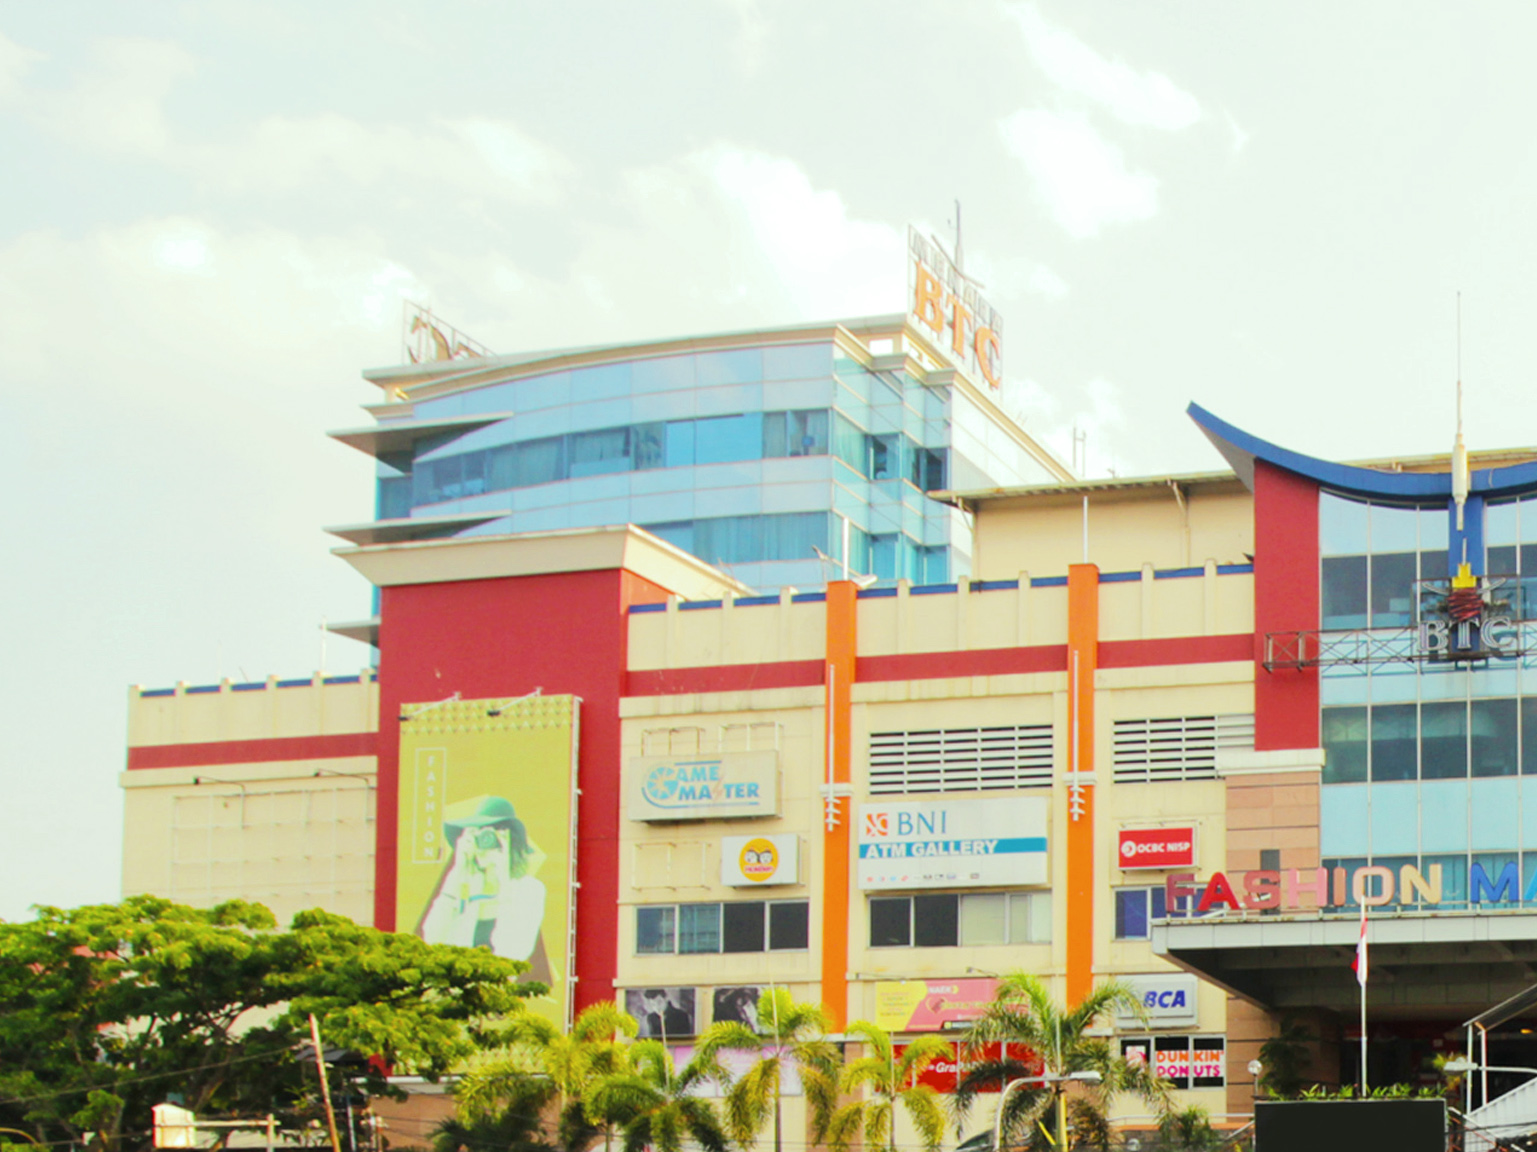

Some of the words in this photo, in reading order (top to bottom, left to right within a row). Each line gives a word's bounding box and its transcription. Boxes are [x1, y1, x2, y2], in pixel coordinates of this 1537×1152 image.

[913, 258, 1002, 390] BTC
[1415, 615, 1516, 654] BTC
[423, 754, 436, 858] FASHION
[897, 810, 948, 836] BNI
[865, 842, 907, 859] ATM
[910, 839, 999, 857] GALLERY
[1137, 842, 1165, 854] OCBC
[1166, 841, 1191, 853] NISP
[1165, 862, 1443, 913] FASHION
[1142, 990, 1186, 1008] BCA
[1156, 1050, 1225, 1063] DUNKIN'
[1156, 1064, 1221, 1078] DONUTS
